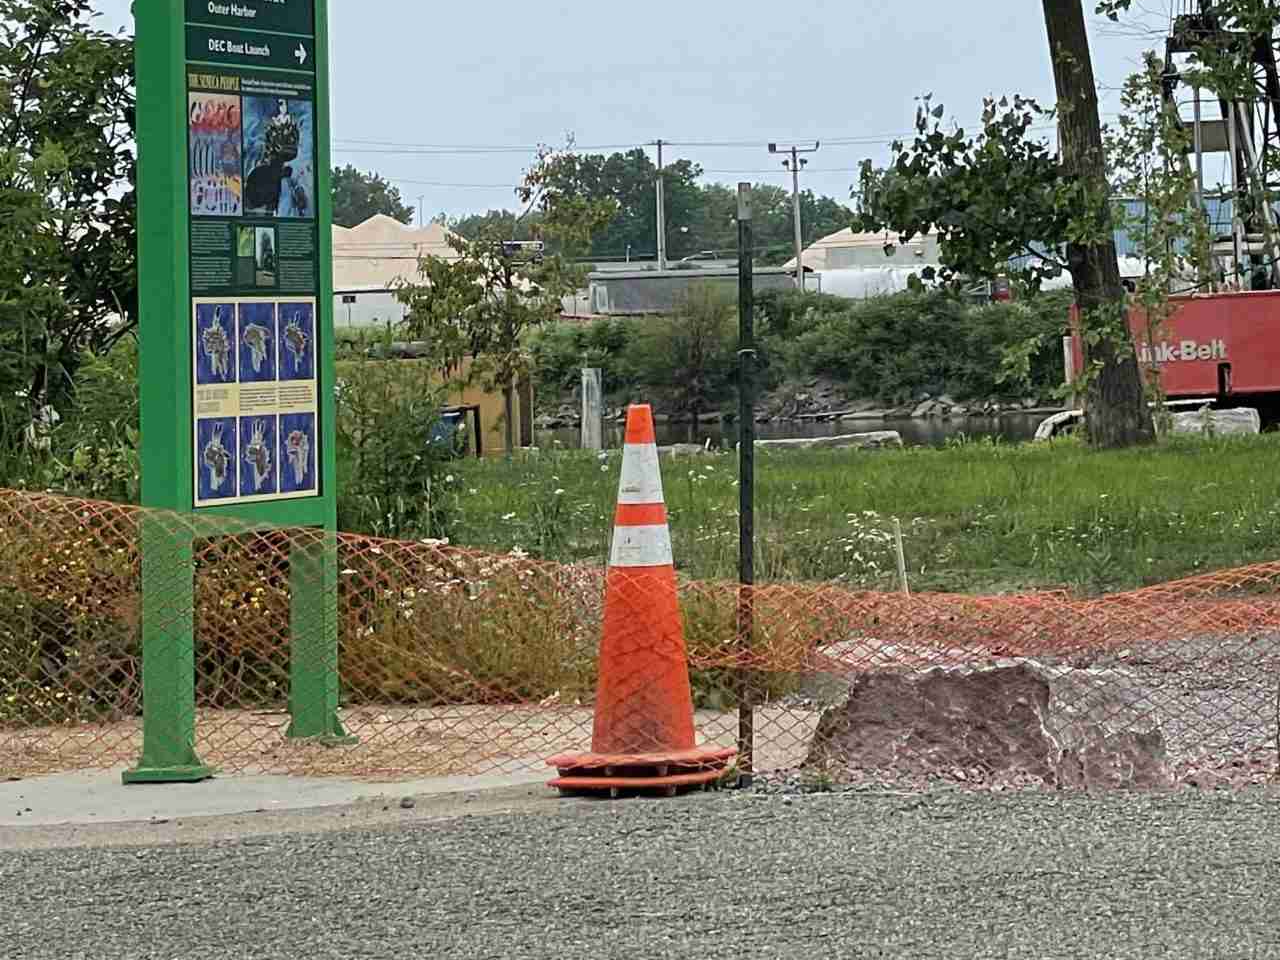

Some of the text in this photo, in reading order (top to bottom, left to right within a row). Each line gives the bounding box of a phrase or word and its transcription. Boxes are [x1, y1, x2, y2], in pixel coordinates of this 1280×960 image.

[207, 1, 256, 18] Outer Harbor
[208, 38, 270, 56] DEC Boat Launch
[1136, 339, 1227, 362] ink-Belt
